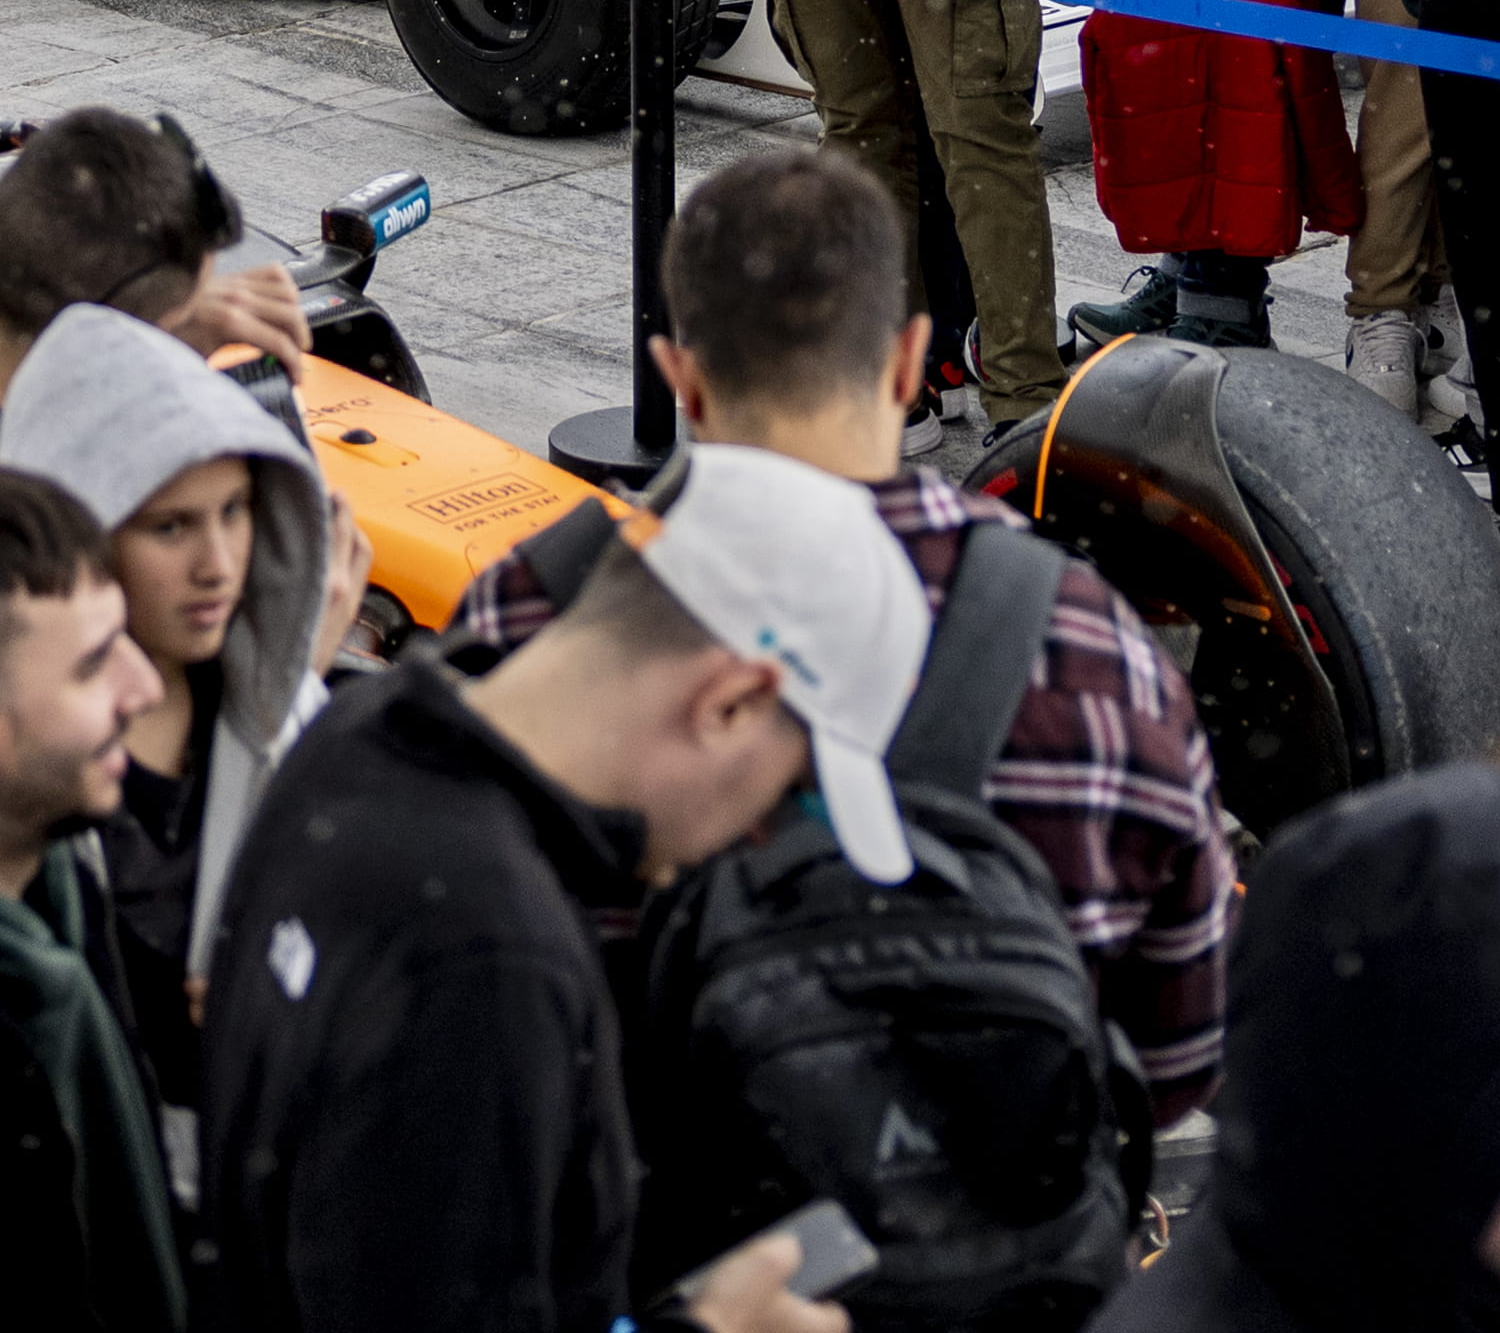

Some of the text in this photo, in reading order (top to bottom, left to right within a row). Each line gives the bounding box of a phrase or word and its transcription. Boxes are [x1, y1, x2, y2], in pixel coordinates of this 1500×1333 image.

[383, 196, 427, 239] allwyn
[427, 481, 528, 517] Hilton
[454, 494, 561, 532] FOR THE STAY
